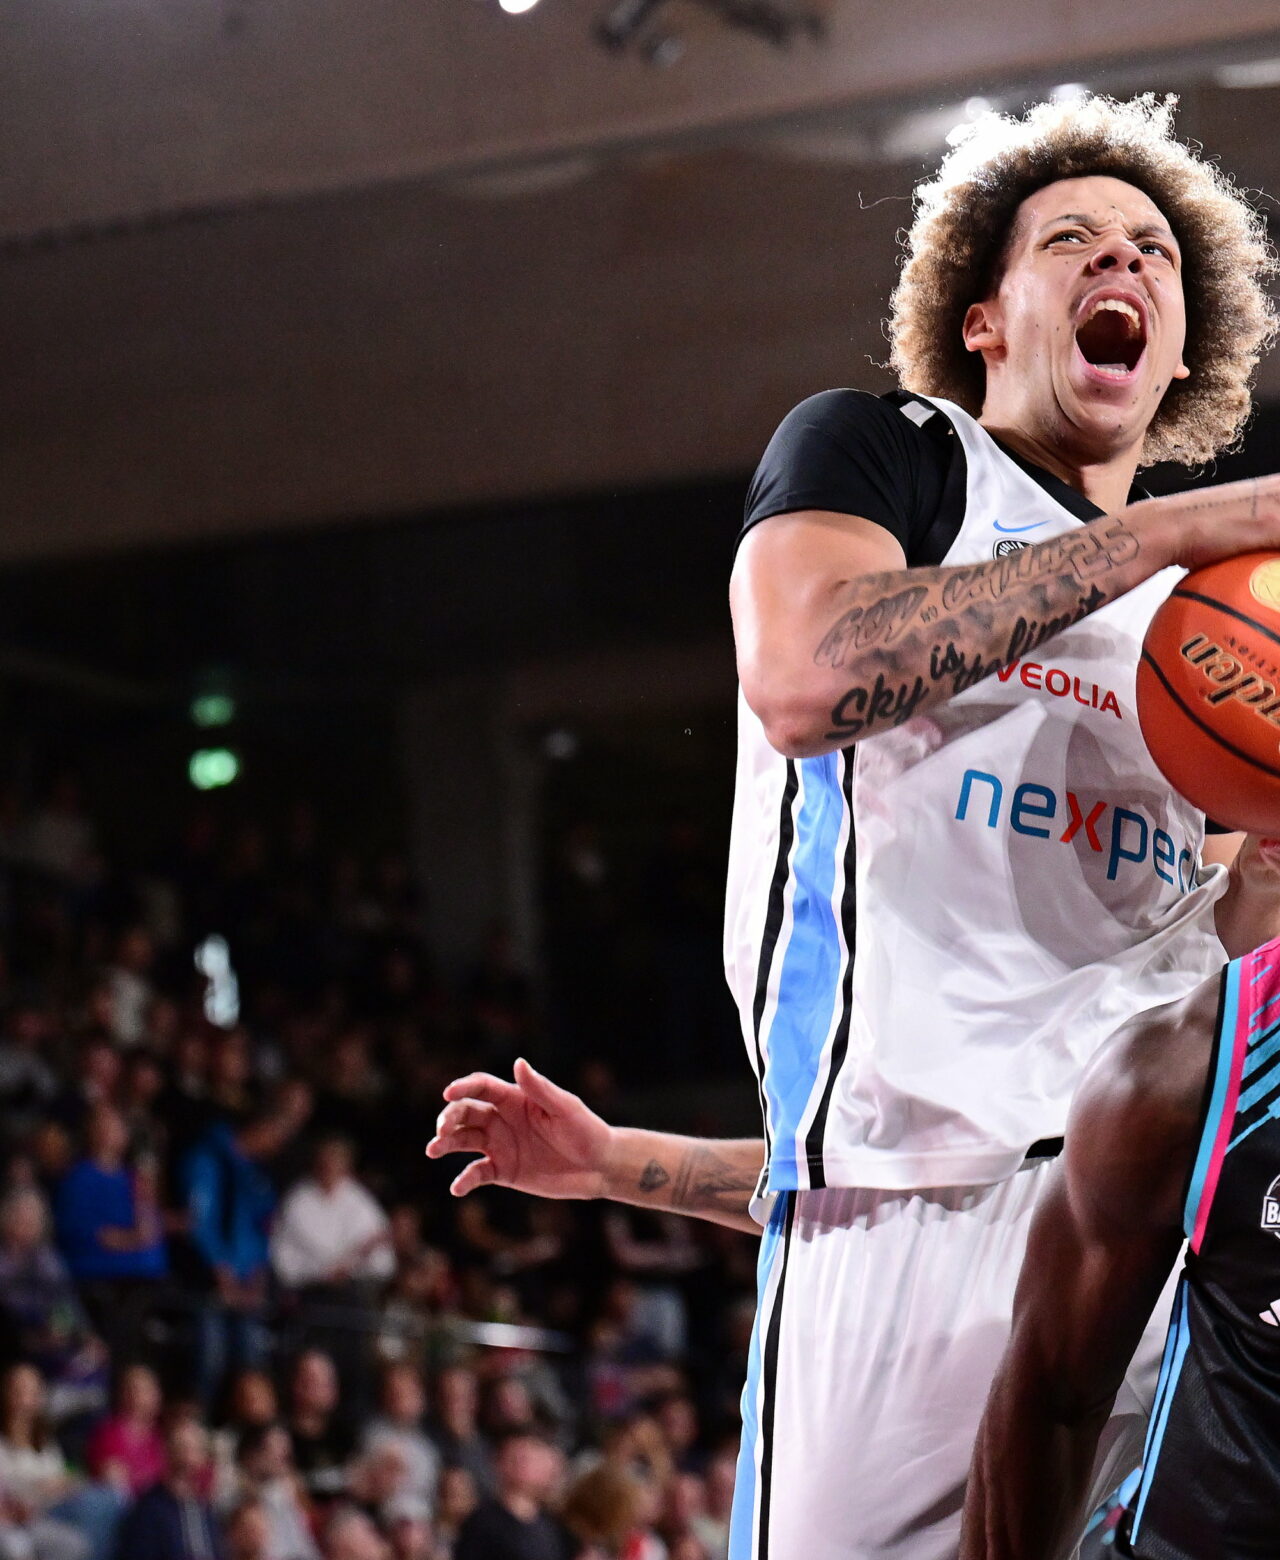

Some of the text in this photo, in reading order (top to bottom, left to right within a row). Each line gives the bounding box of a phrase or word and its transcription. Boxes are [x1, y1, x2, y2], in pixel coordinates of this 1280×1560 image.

[824, 673, 930, 740] Sky
[930, 641, 965, 681] is
[997, 658, 1123, 719] VEOLIA
[955, 769, 1197, 894] nexper
